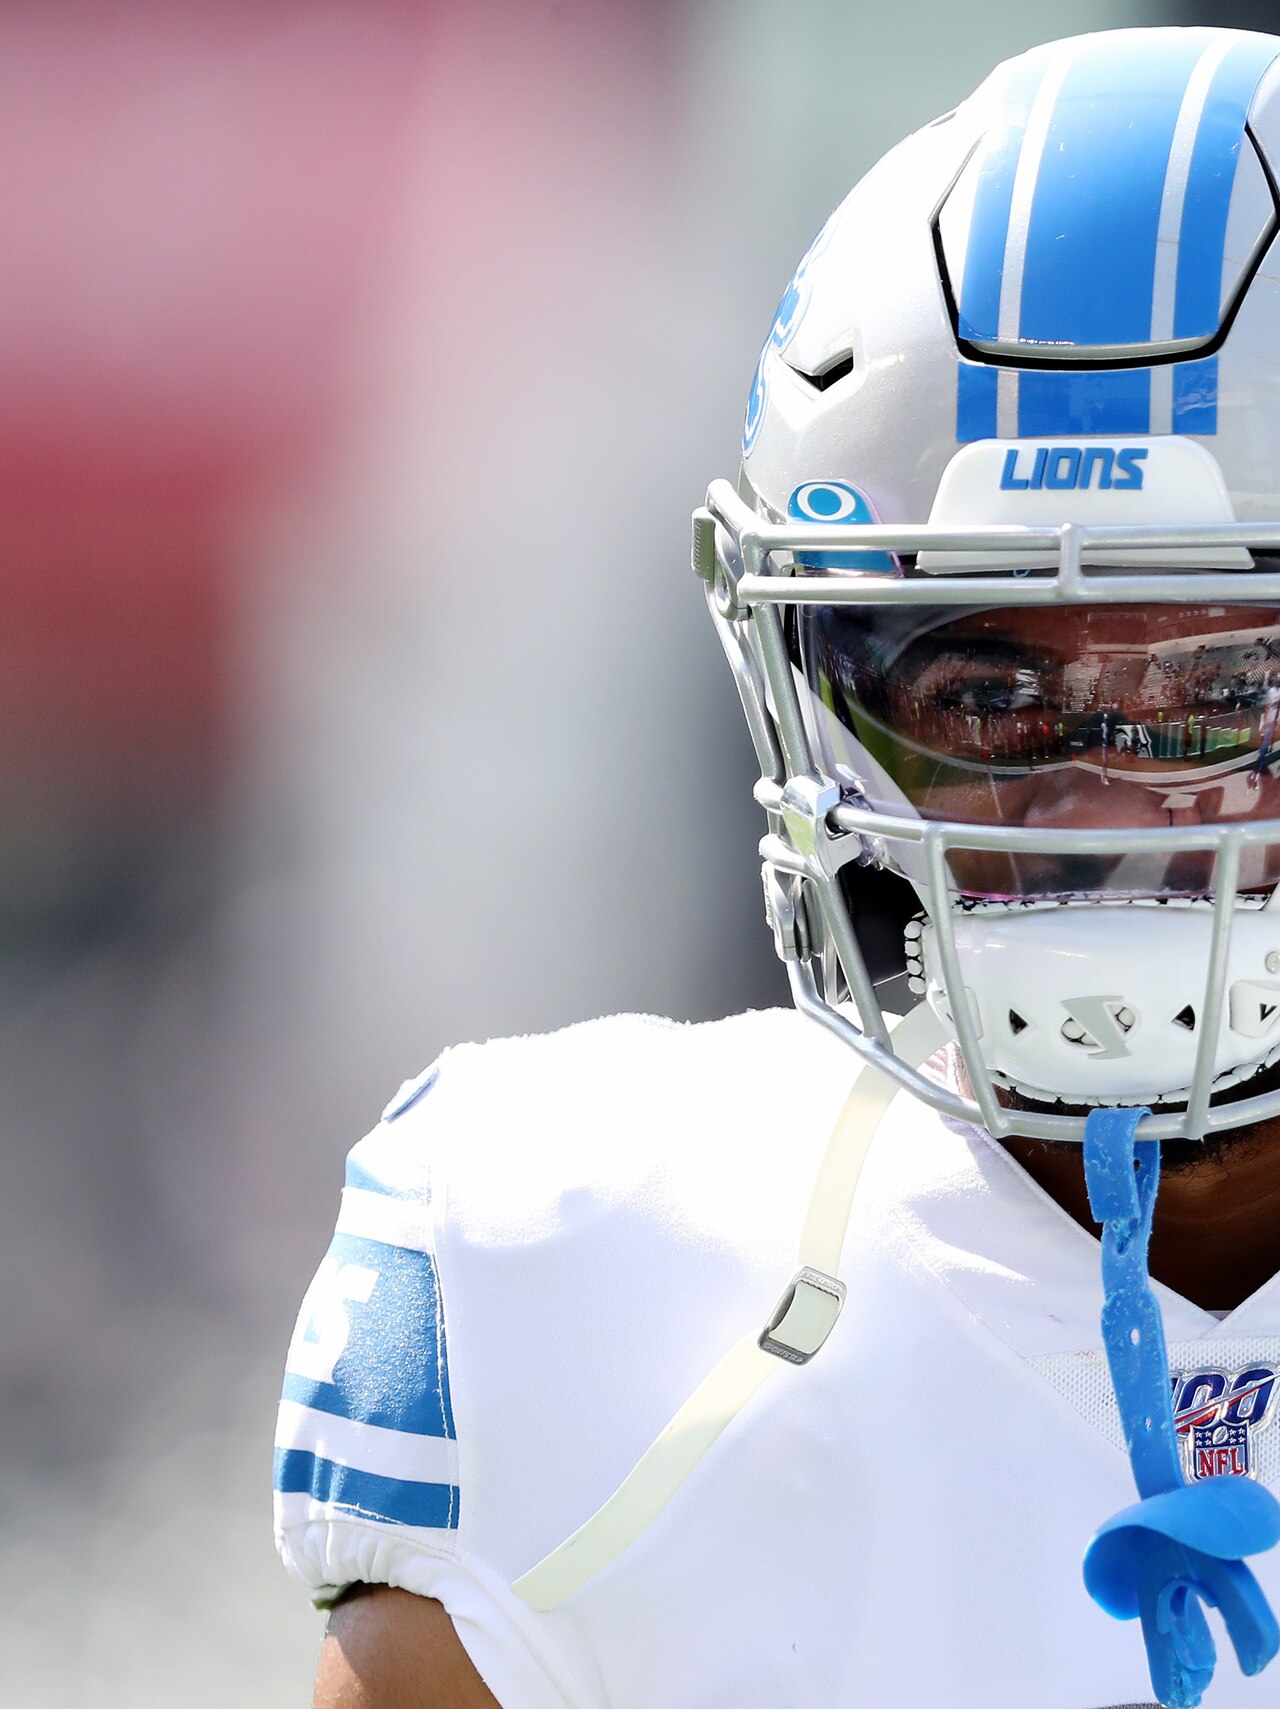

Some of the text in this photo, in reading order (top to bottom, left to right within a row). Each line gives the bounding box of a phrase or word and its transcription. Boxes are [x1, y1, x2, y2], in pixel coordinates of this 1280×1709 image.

[1000, 447, 1149, 490] LIONS
[1171, 1368, 1278, 1427] 00
[1199, 1448, 1245, 1477] NFL
